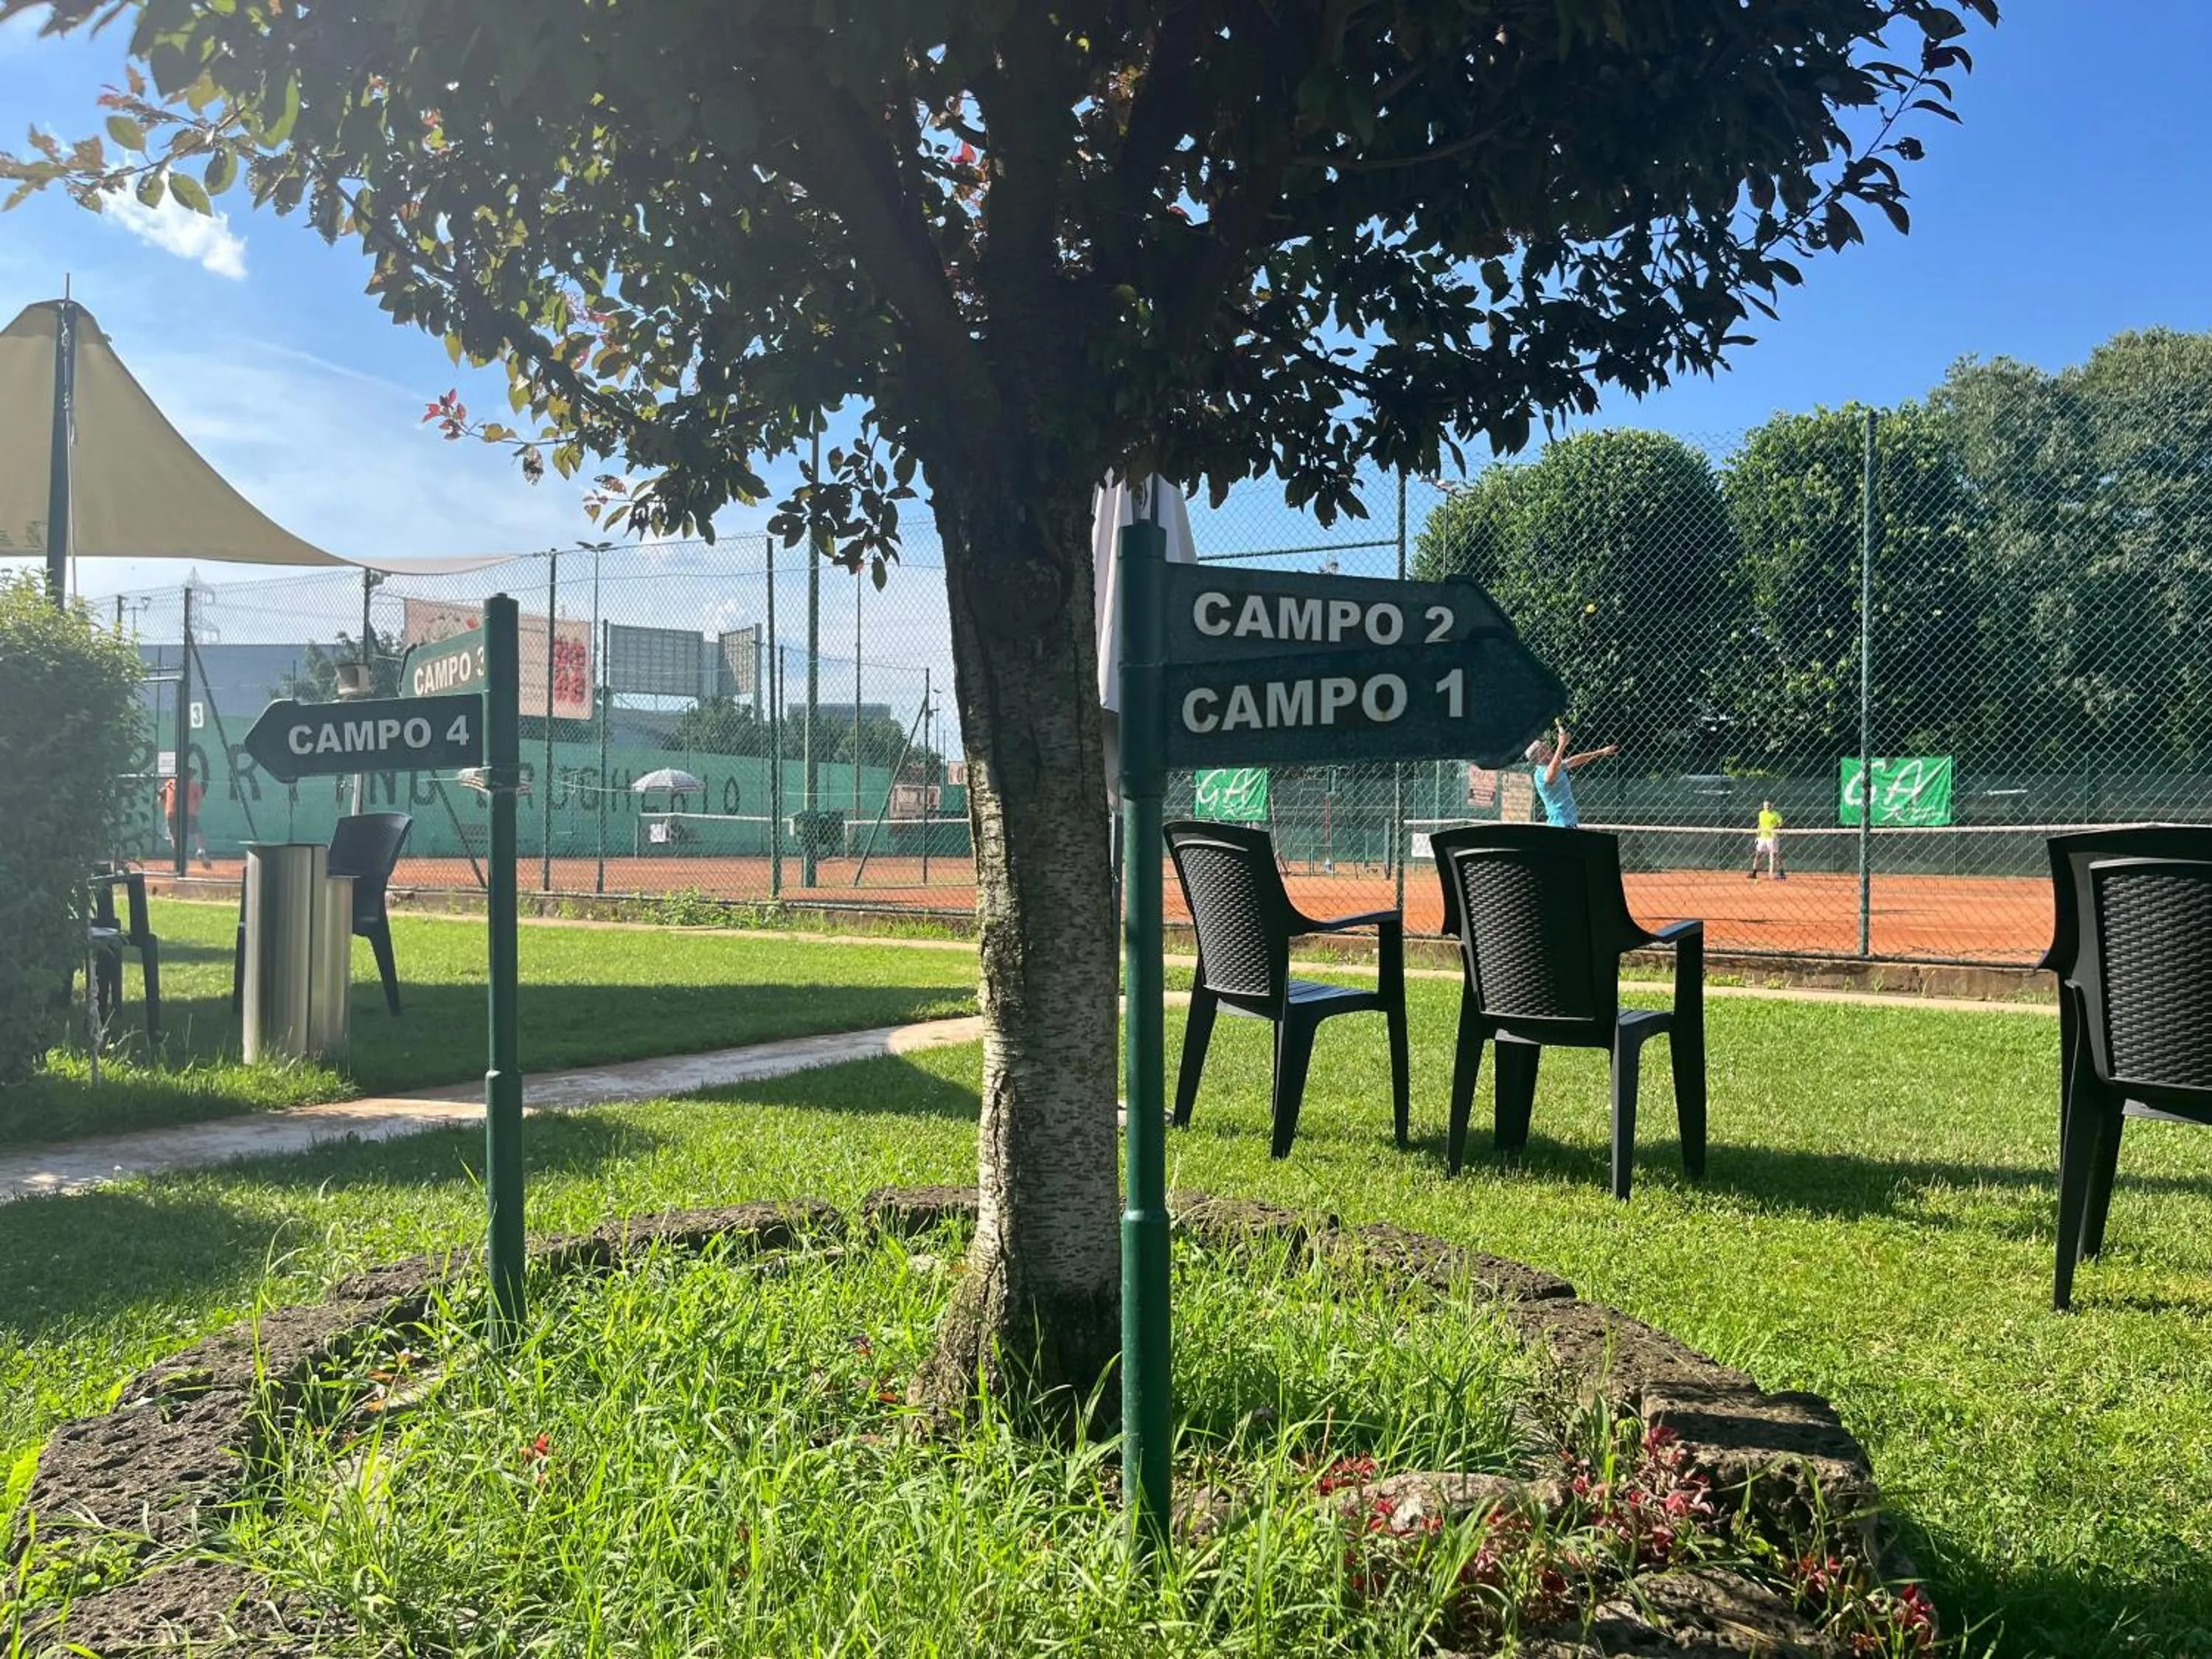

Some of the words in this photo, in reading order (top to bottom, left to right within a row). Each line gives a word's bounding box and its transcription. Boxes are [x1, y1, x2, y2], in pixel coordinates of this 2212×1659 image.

[1193, 592, 1403, 644] CAMPO
[1425, 605, 1455, 644] 2
[414, 652, 471, 696] CAMPO
[1182, 673, 1408, 733] CAMPO
[1436, 669, 1464, 718] 1
[288, 717, 431, 755] CAMPO
[446, 714, 470, 746] 4
